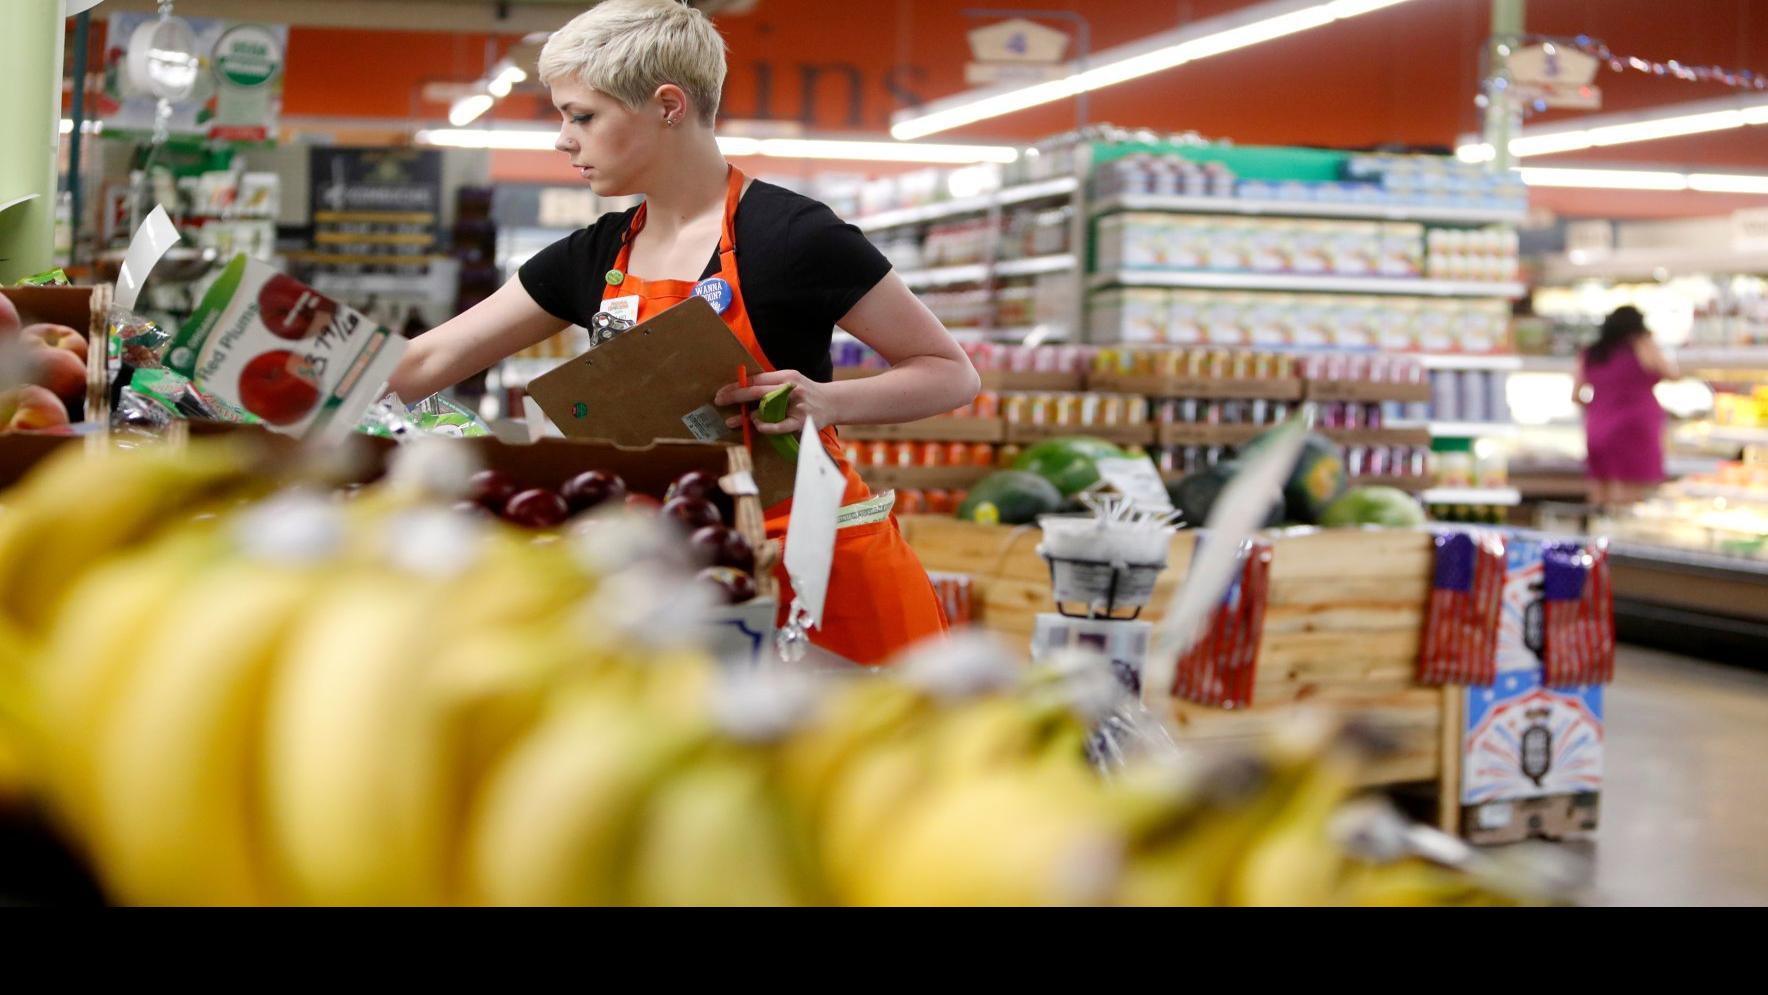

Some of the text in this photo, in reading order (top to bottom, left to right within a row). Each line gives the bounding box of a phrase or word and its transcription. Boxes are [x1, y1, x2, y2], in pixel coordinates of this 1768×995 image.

[1005, 32, 1028, 55] 4
[695, 282, 723, 296] WANNA
[704, 291, 722, 302] OON?
[195, 348, 227, 383] Red
[218, 300, 259, 351] Plums
